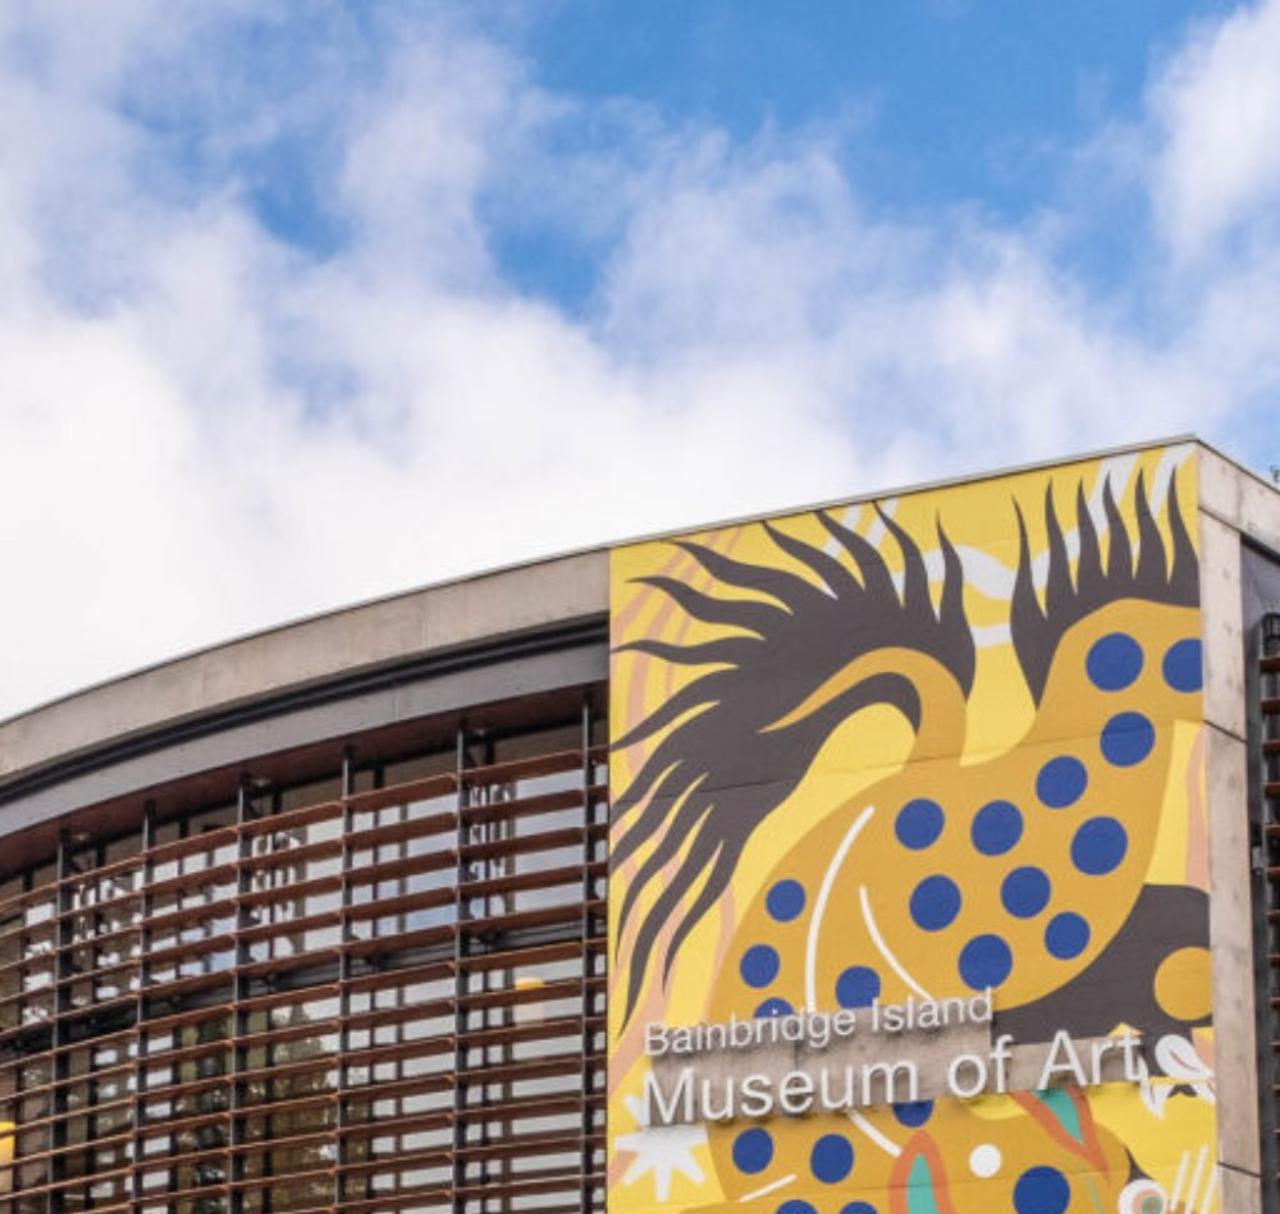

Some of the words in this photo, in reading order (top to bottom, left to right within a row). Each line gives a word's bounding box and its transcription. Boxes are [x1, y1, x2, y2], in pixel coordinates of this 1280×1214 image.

[644, 1006, 856, 1058] Bainbridge
[871, 986, 993, 1033] Island
[642, 1059, 917, 1126] Museum
[948, 1034, 1014, 1098] of
[1038, 1029, 1145, 1091] Art
